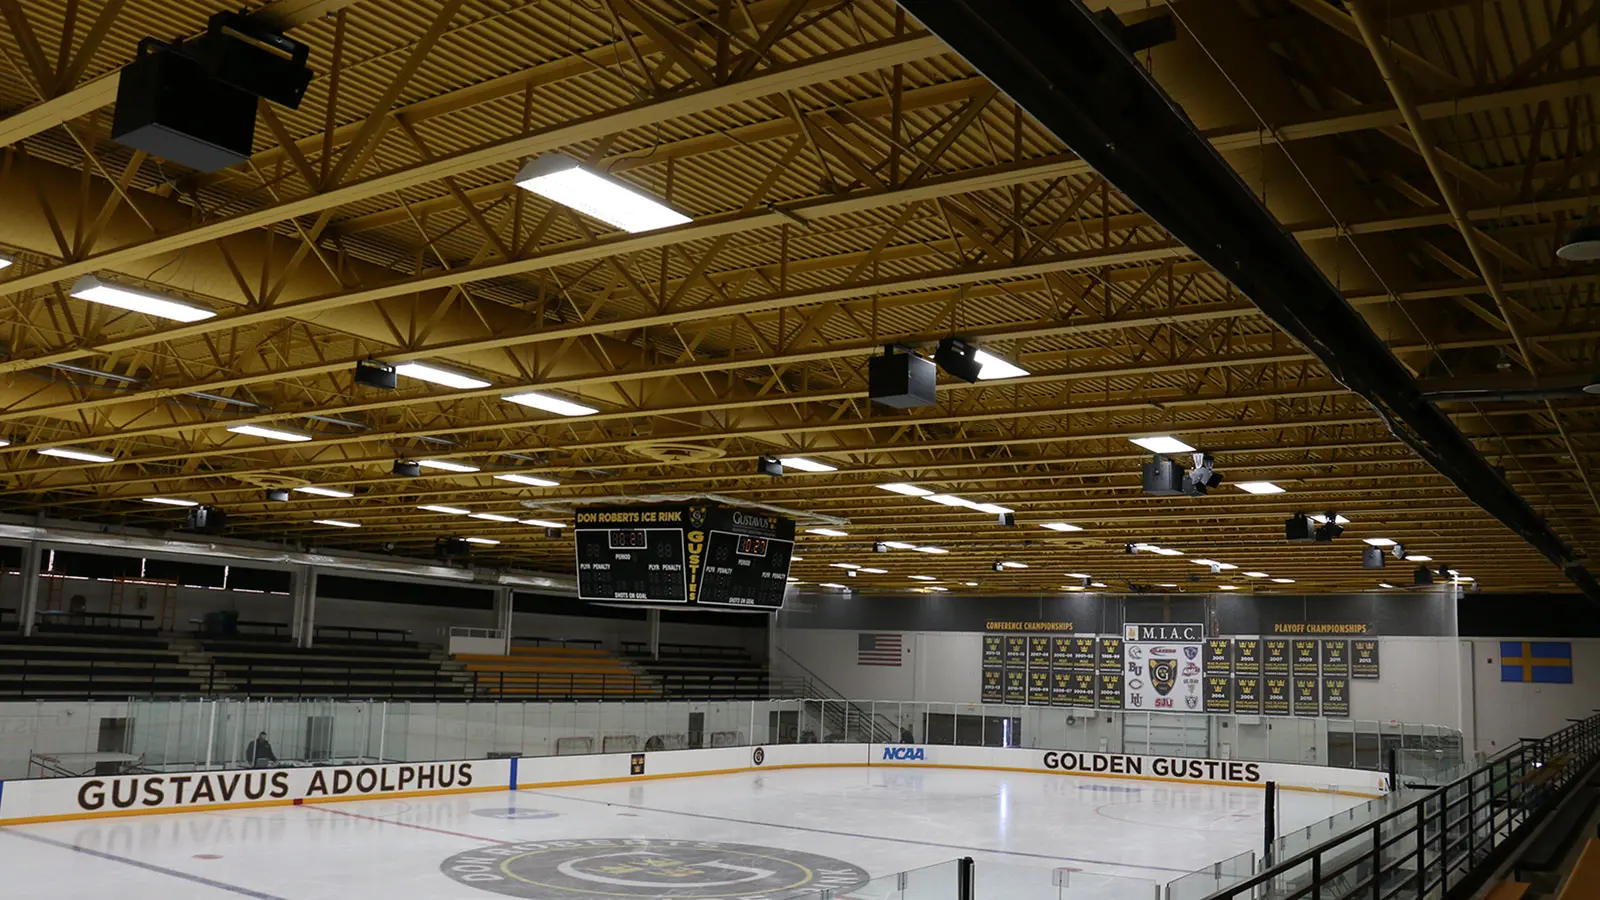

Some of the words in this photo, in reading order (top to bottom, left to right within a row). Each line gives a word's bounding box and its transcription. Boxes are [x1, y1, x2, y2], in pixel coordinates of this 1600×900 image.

[577, 513, 597, 522] DON
[598, 512, 640, 522] ROBERTS
[641, 512, 657, 521] ICE
[658, 511, 682, 521] RINK
[687, 530, 705, 601] GUSTIES
[986, 621, 1023, 630] CONFERENCE
[1023, 622, 1073, 631] CHAMPIONSHIPS
[1274, 623, 1305, 633] PLAYOFF
[1306, 624, 1367, 633] CHAMPIONSHIPS
[1155, 698, 1173, 708] SJU
[883, 747, 924, 760] NCAA
[1043, 751, 1143, 775] GOLDEN
[1152, 758, 1260, 782] GUSTIES
[77, 770, 290, 811] GUSTAVUS
[306, 763, 473, 796] ADOLPHUS
[451, 856, 505, 882] DON
